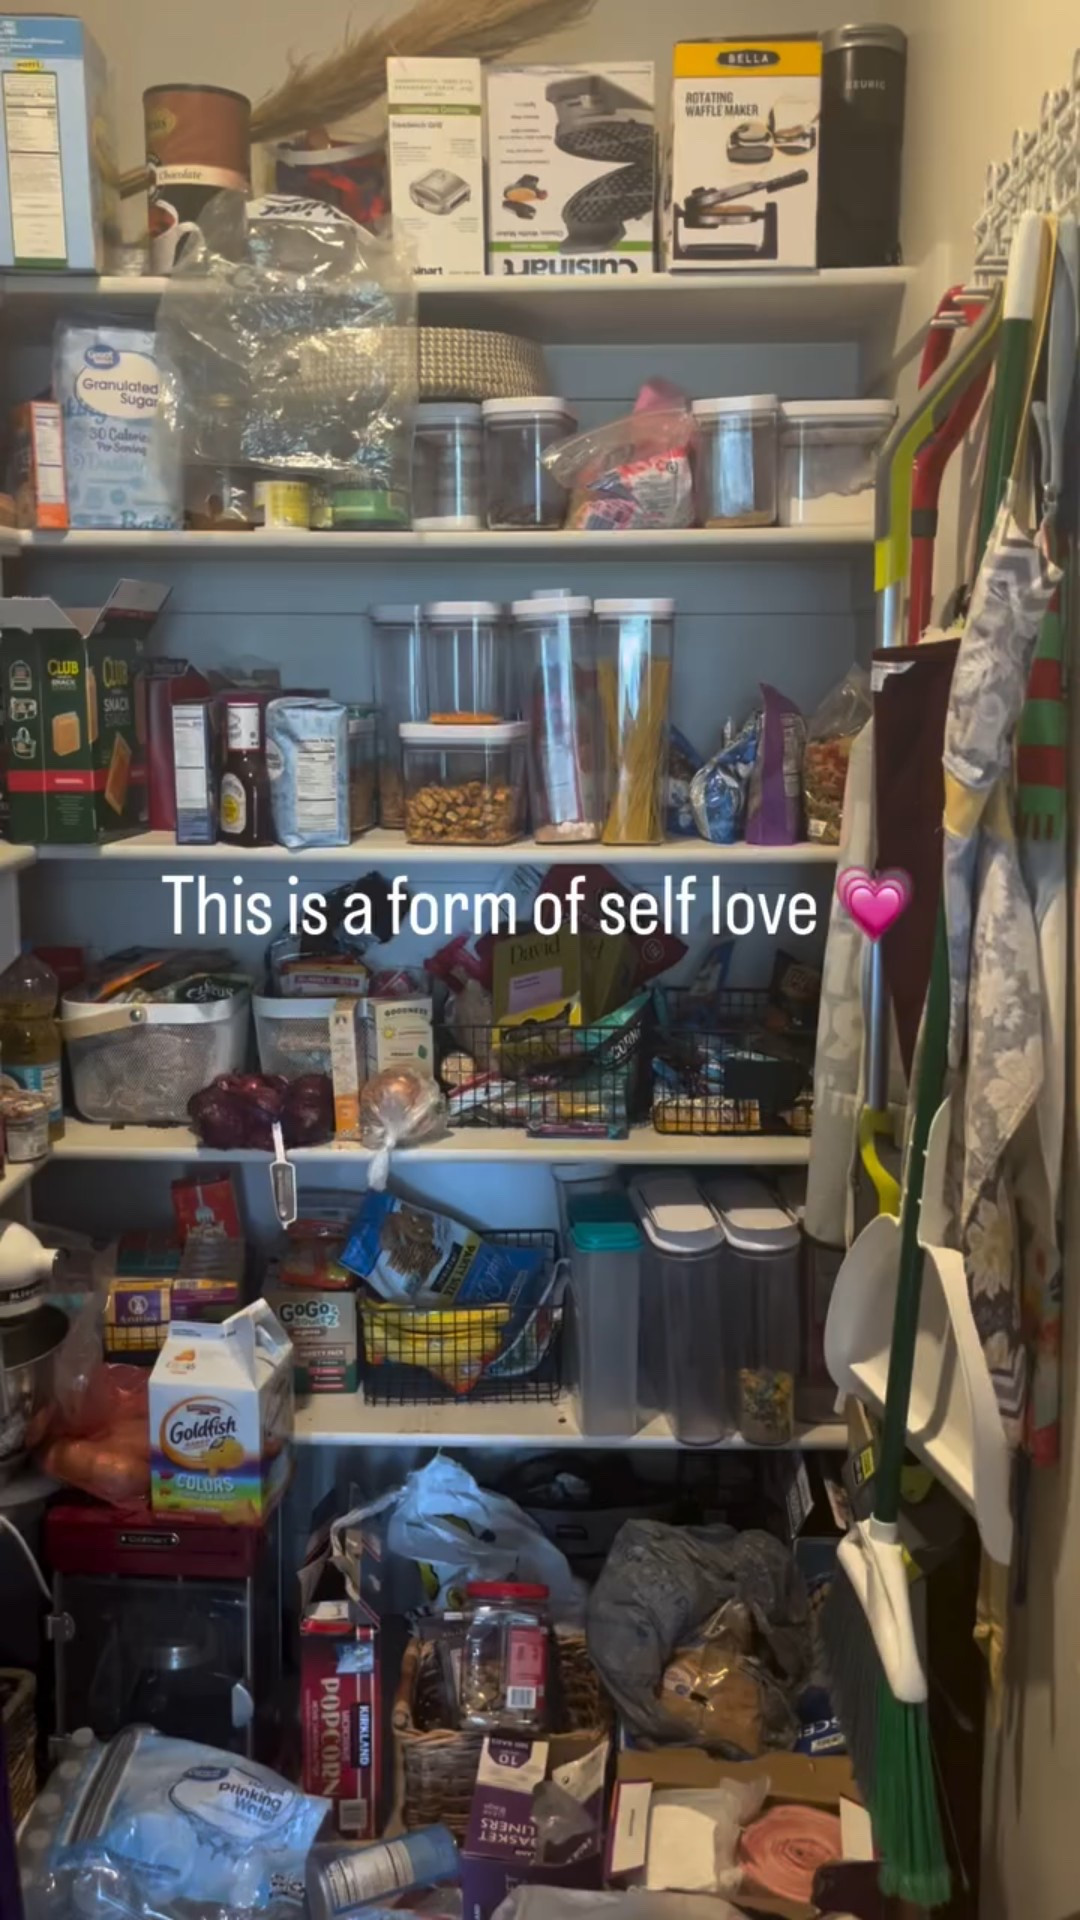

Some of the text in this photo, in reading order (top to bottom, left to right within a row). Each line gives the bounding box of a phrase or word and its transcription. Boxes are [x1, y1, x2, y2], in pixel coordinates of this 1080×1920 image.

[728, 53, 769, 64] BELLA
[685, 91, 734, 104] ROTATING
[685, 104, 759, 117] WAFFLE MAKER
[158, 167, 203, 181] Chocolate
[82, 378, 159, 395] Granulated
[120, 392, 158, 409] Sugar
[89, 427, 106, 440] 30
[48, 660, 79, 675] CLUB
[103, 656, 128, 688] CLUB
[104, 697, 129, 712] SNACK
[511, 932, 560, 965] David
[280, 1301, 329, 1322] GoGo
[170, 1416, 237, 1444] Goldfish
[176, 1473, 235, 1493] COLORS
[320, 1677, 340, 1796] POPCORN
[359, 1704, 370, 1766] KIRKLAND
[499, 1754, 518, 1766] 10
[234, 1797, 278, 1822] Water
[480, 1817, 536, 1835] LINERS
